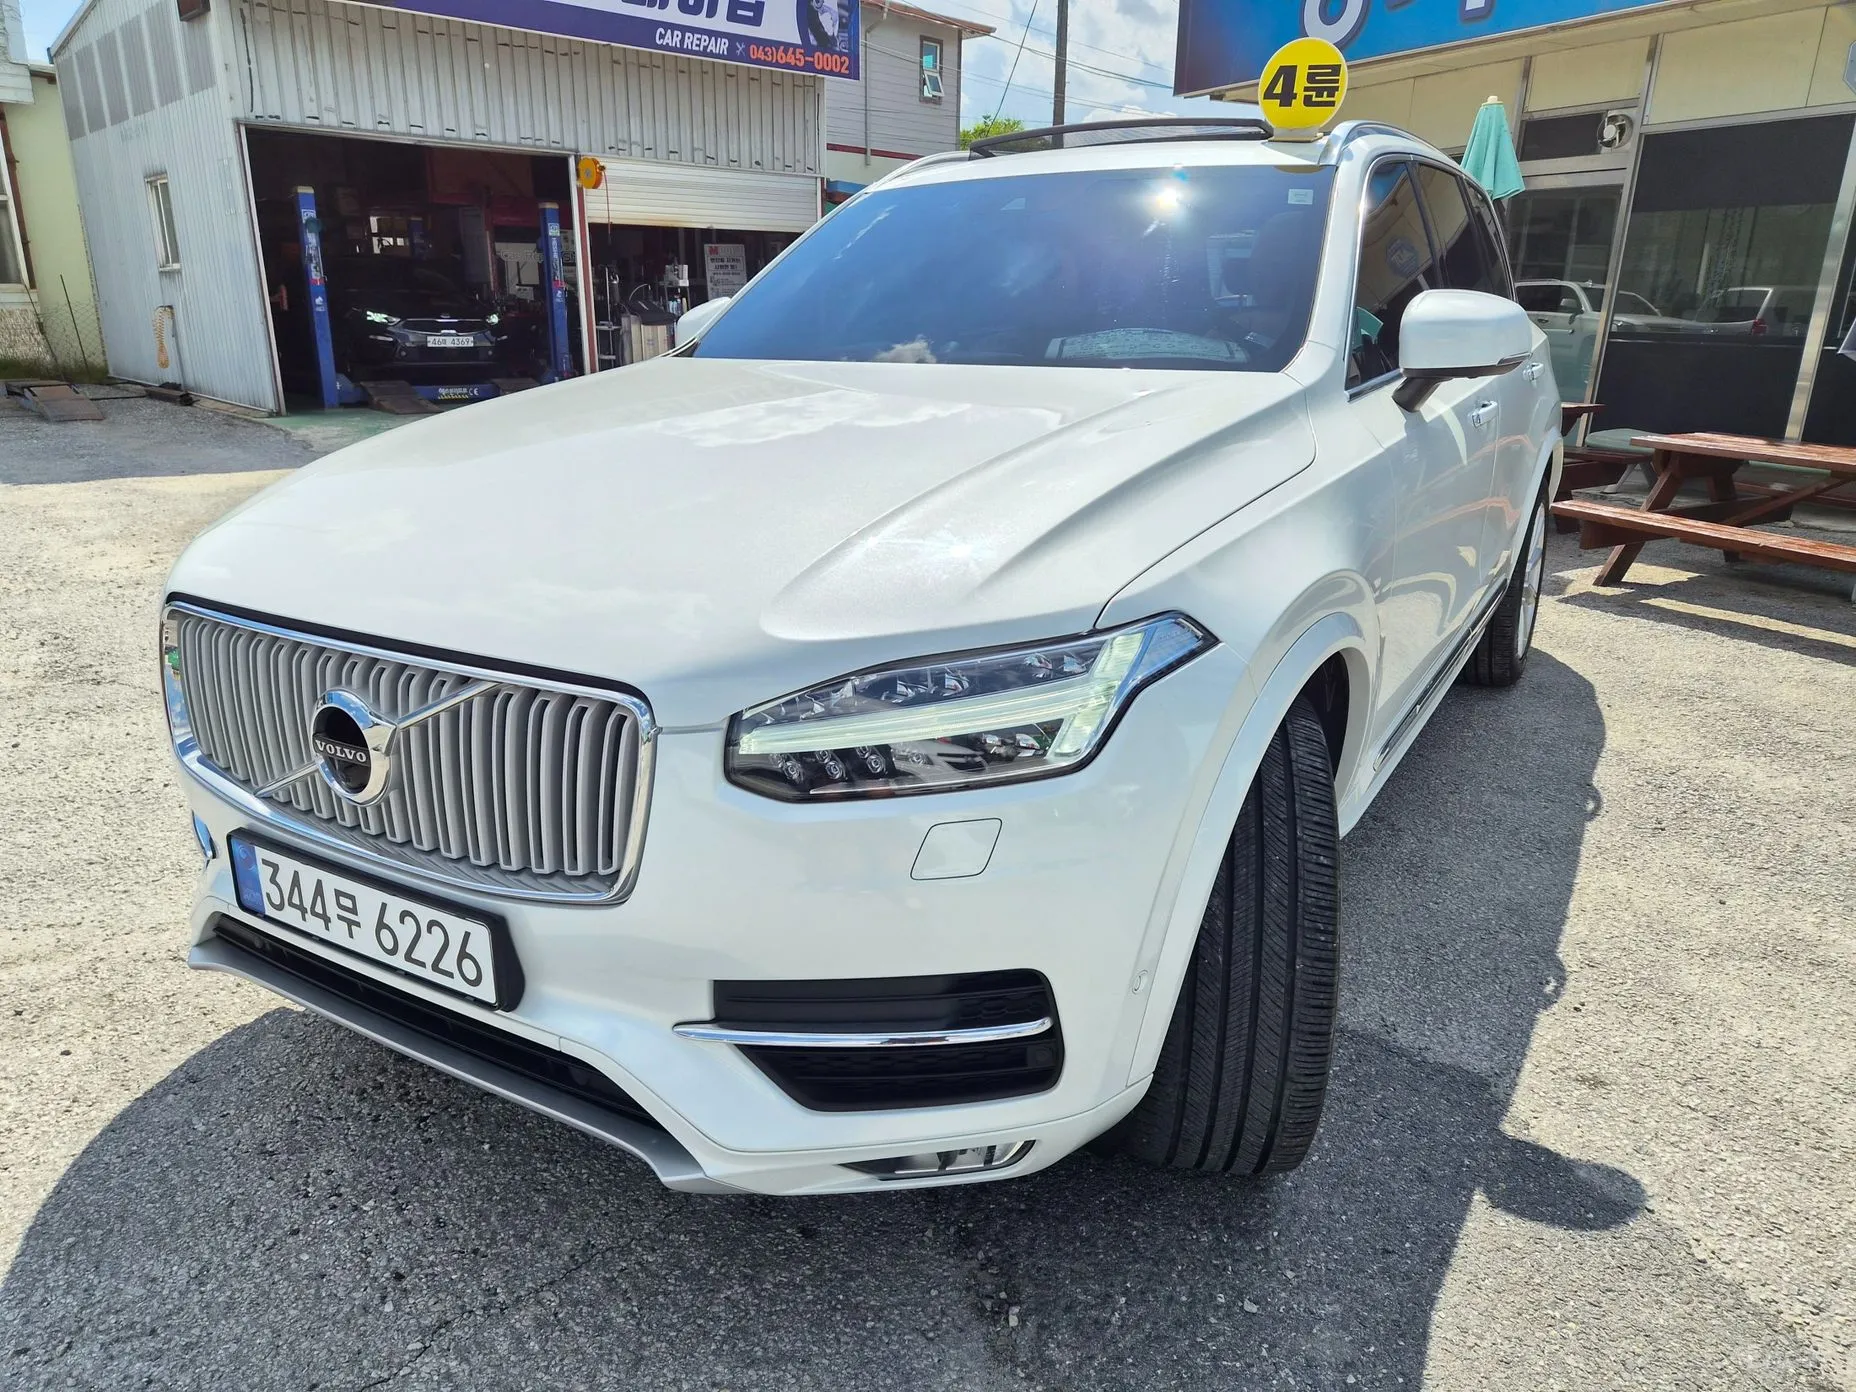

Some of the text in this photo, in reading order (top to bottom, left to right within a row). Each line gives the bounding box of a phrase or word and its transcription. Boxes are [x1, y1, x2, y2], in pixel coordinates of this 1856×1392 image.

[655, 27, 850, 74] CAR REPAIR 043)645-0002
[1263, 63, 1342, 108] 4륜
[450, 338, 470, 346] 4369
[315, 739, 367, 763] VOLVO
[261, 858, 483, 988] 344무 6226
